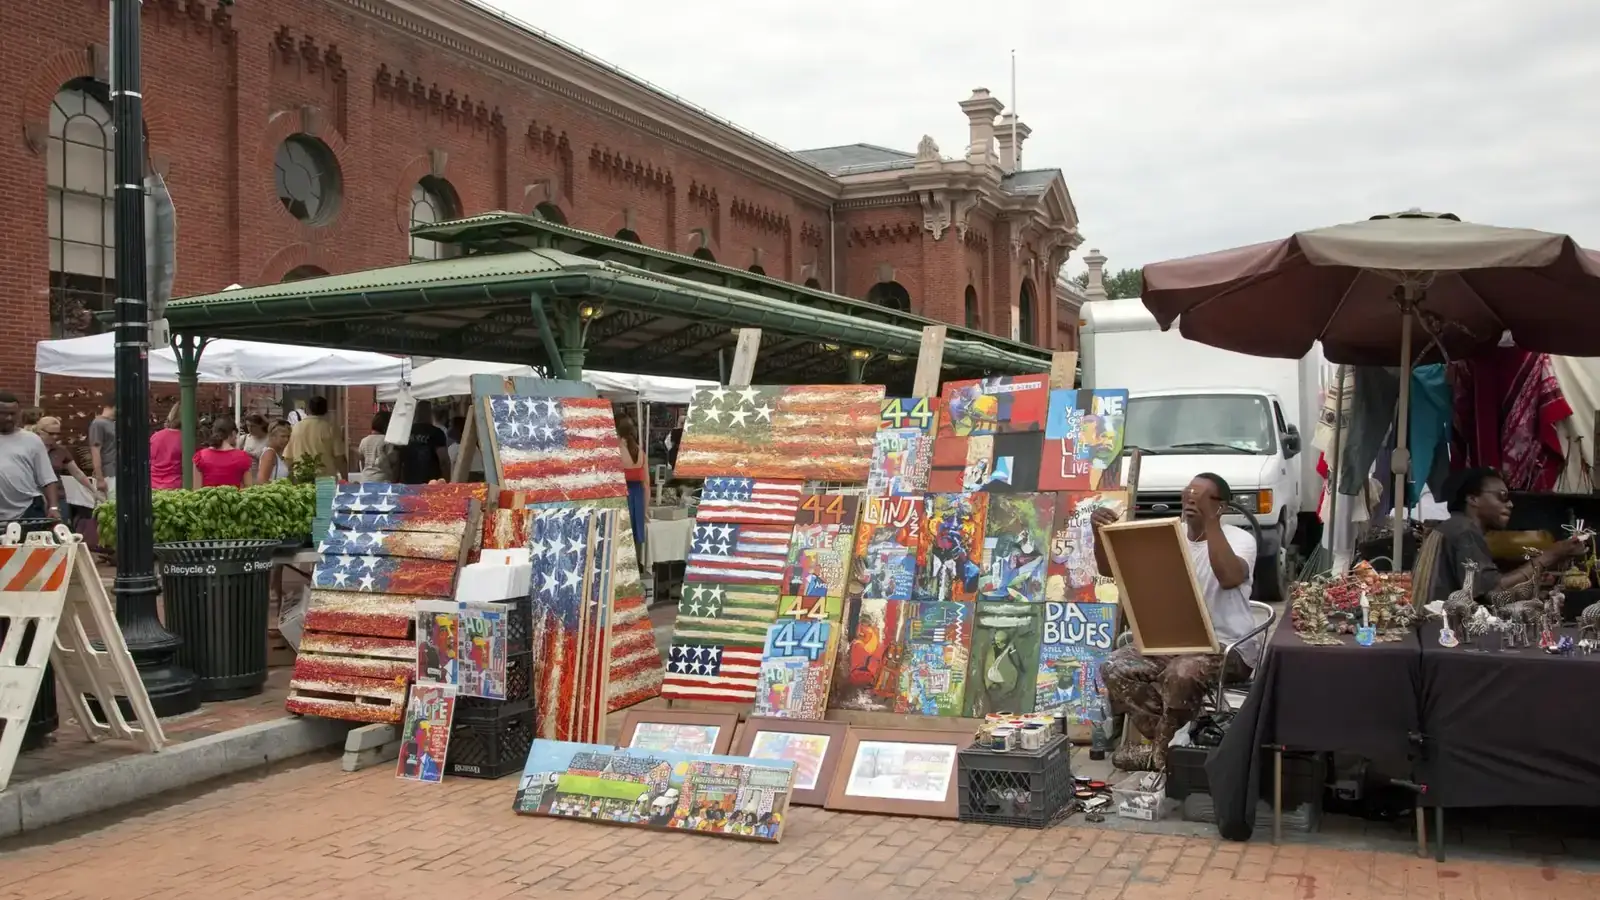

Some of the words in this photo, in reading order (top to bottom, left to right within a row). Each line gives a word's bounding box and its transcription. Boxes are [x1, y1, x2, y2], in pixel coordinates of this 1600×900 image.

[882, 396, 933, 428] 44
[1061, 456, 1089, 478] LIVE
[802, 495, 847, 524] 44
[1055, 539, 1075, 556] 55
[170, 564, 204, 576] Recycle
[785, 595, 829, 620] 44
[1045, 602, 1087, 622] DA
[774, 620, 824, 660] 44
[1043, 621, 1111, 649] BLUES
[414, 699, 449, 720] HOPE
